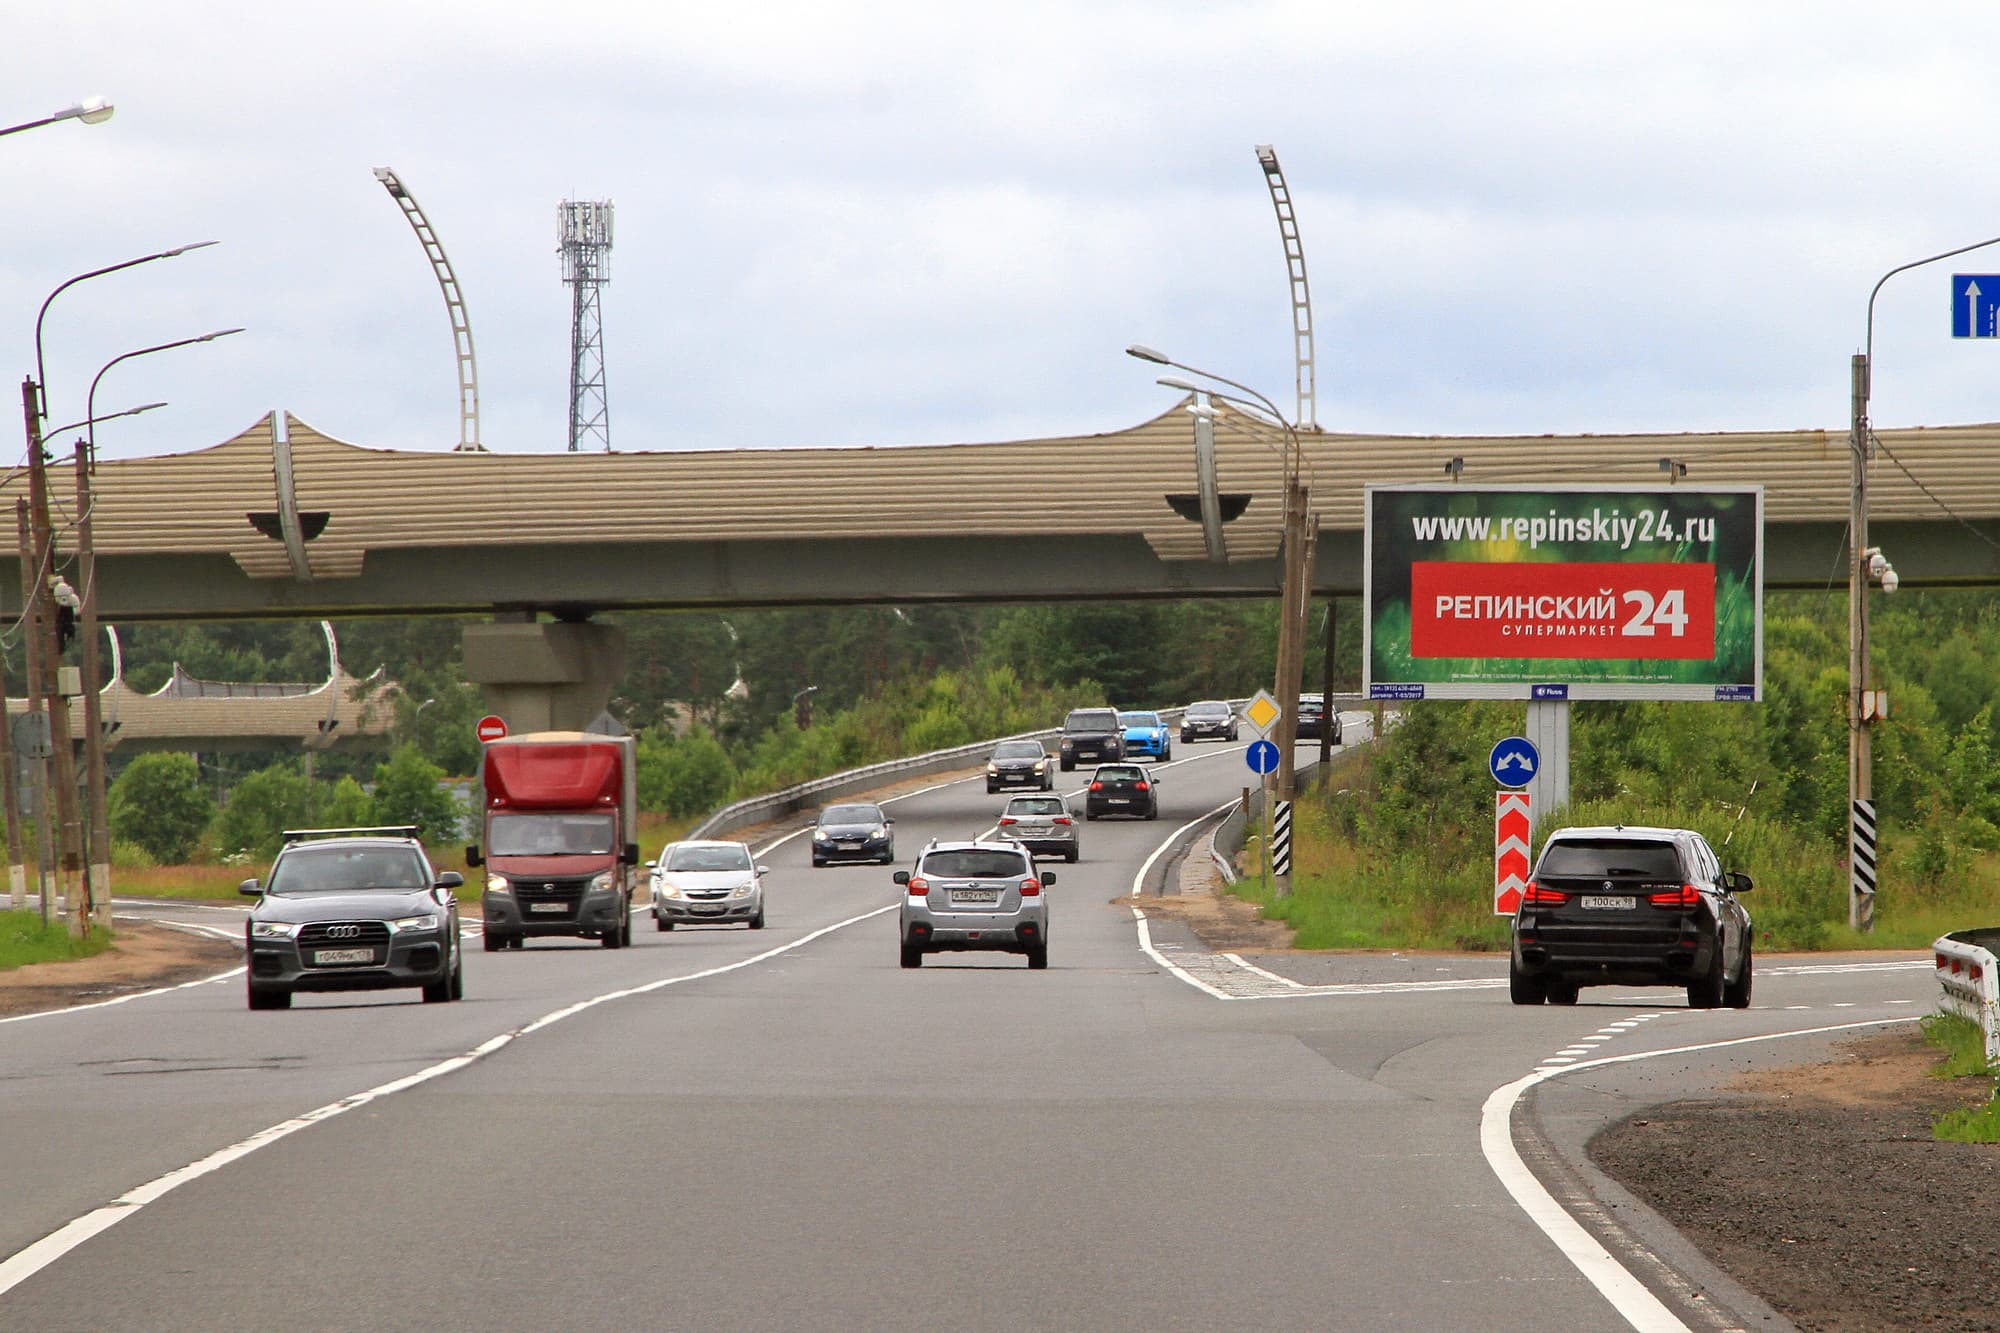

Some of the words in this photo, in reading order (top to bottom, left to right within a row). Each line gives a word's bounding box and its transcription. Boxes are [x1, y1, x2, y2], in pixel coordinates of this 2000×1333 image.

[1412, 508, 1715, 550] www.repinskiy24.ru
[1436, 588, 1616, 619] РЕПИНСКИЙ
[1621, 589, 1689, 637] 24
[1501, 624, 1616, 637] СУПЕРМАРКЕТ
